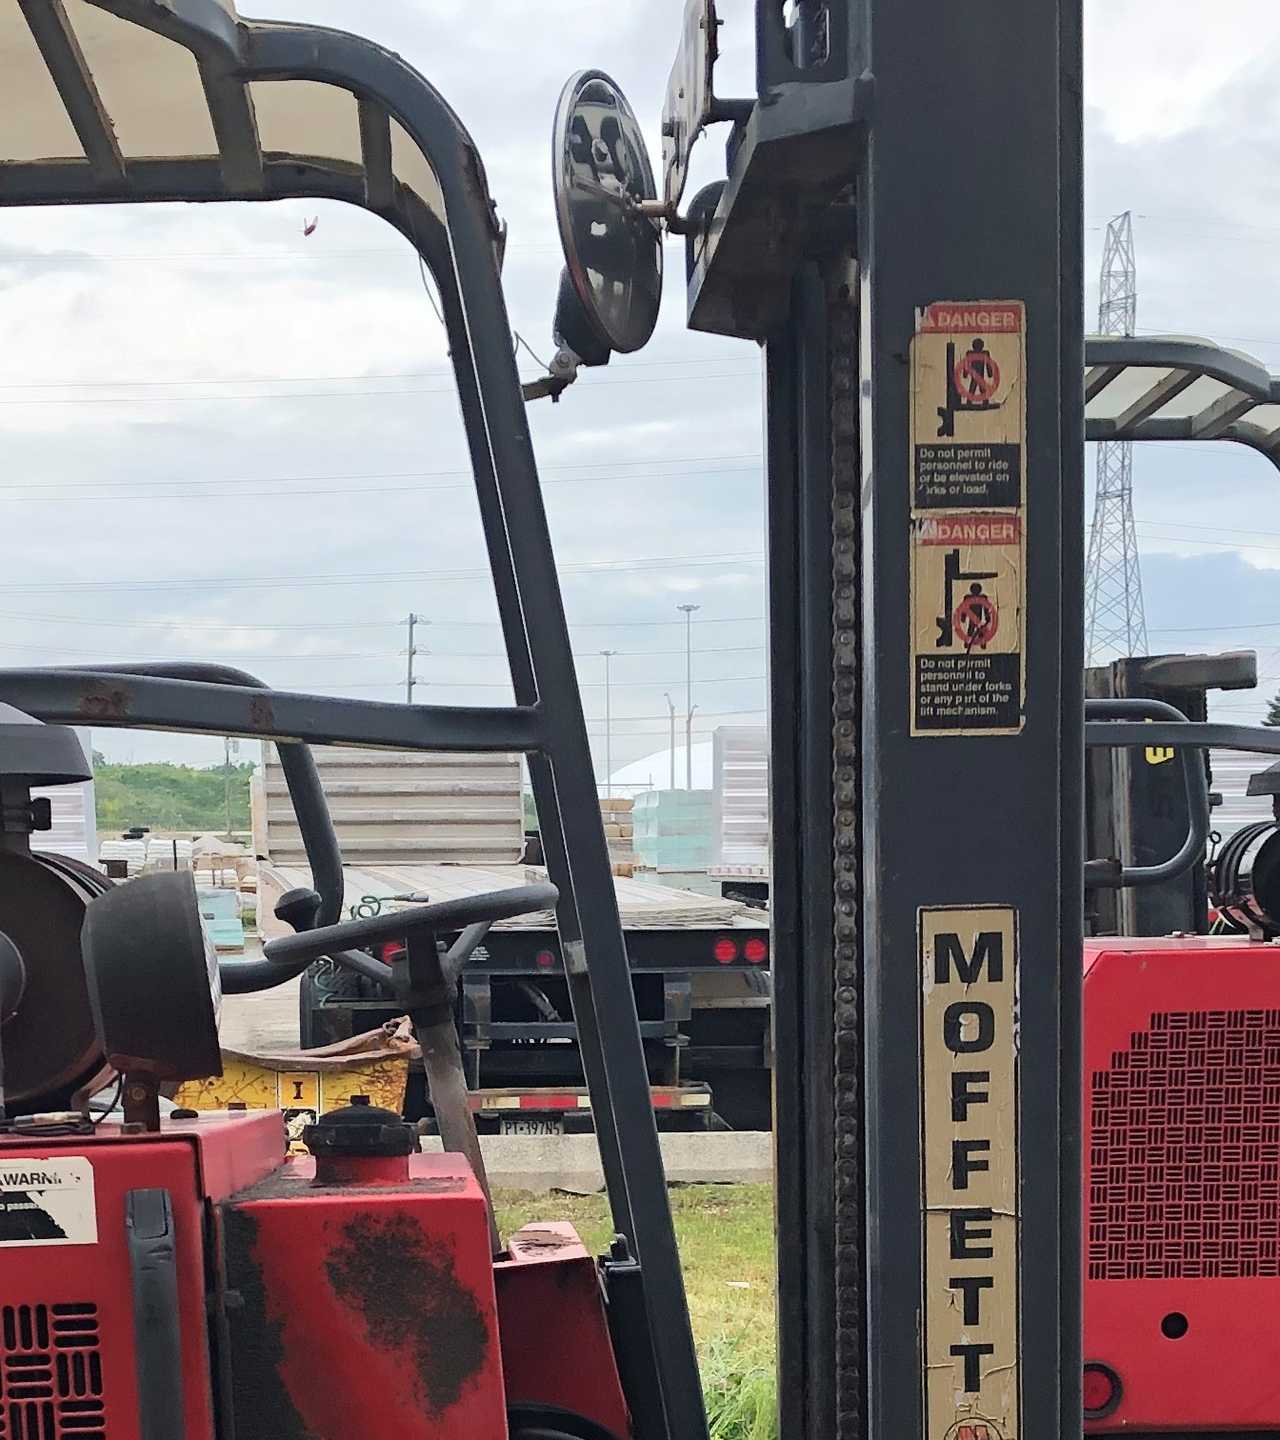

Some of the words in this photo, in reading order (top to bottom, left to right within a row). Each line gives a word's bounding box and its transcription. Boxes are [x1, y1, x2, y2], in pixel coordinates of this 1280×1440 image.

[937, 311, 1015, 328] DANGER
[920, 448, 935, 459] Do
[938, 448, 955, 458] not
[957, 447, 991, 460] permit
[919, 460, 972, 473] personnel
[974, 461, 985, 470] to
[988, 460, 1009, 470] ride
[919, 474, 931, 483] or
[933, 472, 946, 482] be
[949, 472, 993, 482] elevated
[995, 473, 1010, 483] on
[949, 485, 960, 495] or
[937, 523, 1015, 540] DANGER
[920, 658, 935, 669] Do
[938, 658, 955, 669] not
[974, 670, 986, 680] to
[920, 682, 949, 693] stand
[952, 682, 983, 692] under
[985, 681, 1013, 691] forks
[920, 694, 931, 705] or
[933, 694, 953, 706] any
[979, 693, 990, 704] of
[992, 692, 1010, 703] the
[920, 705, 934, 716] lift
[933, 930, 1004, 1394] MOFFETT
